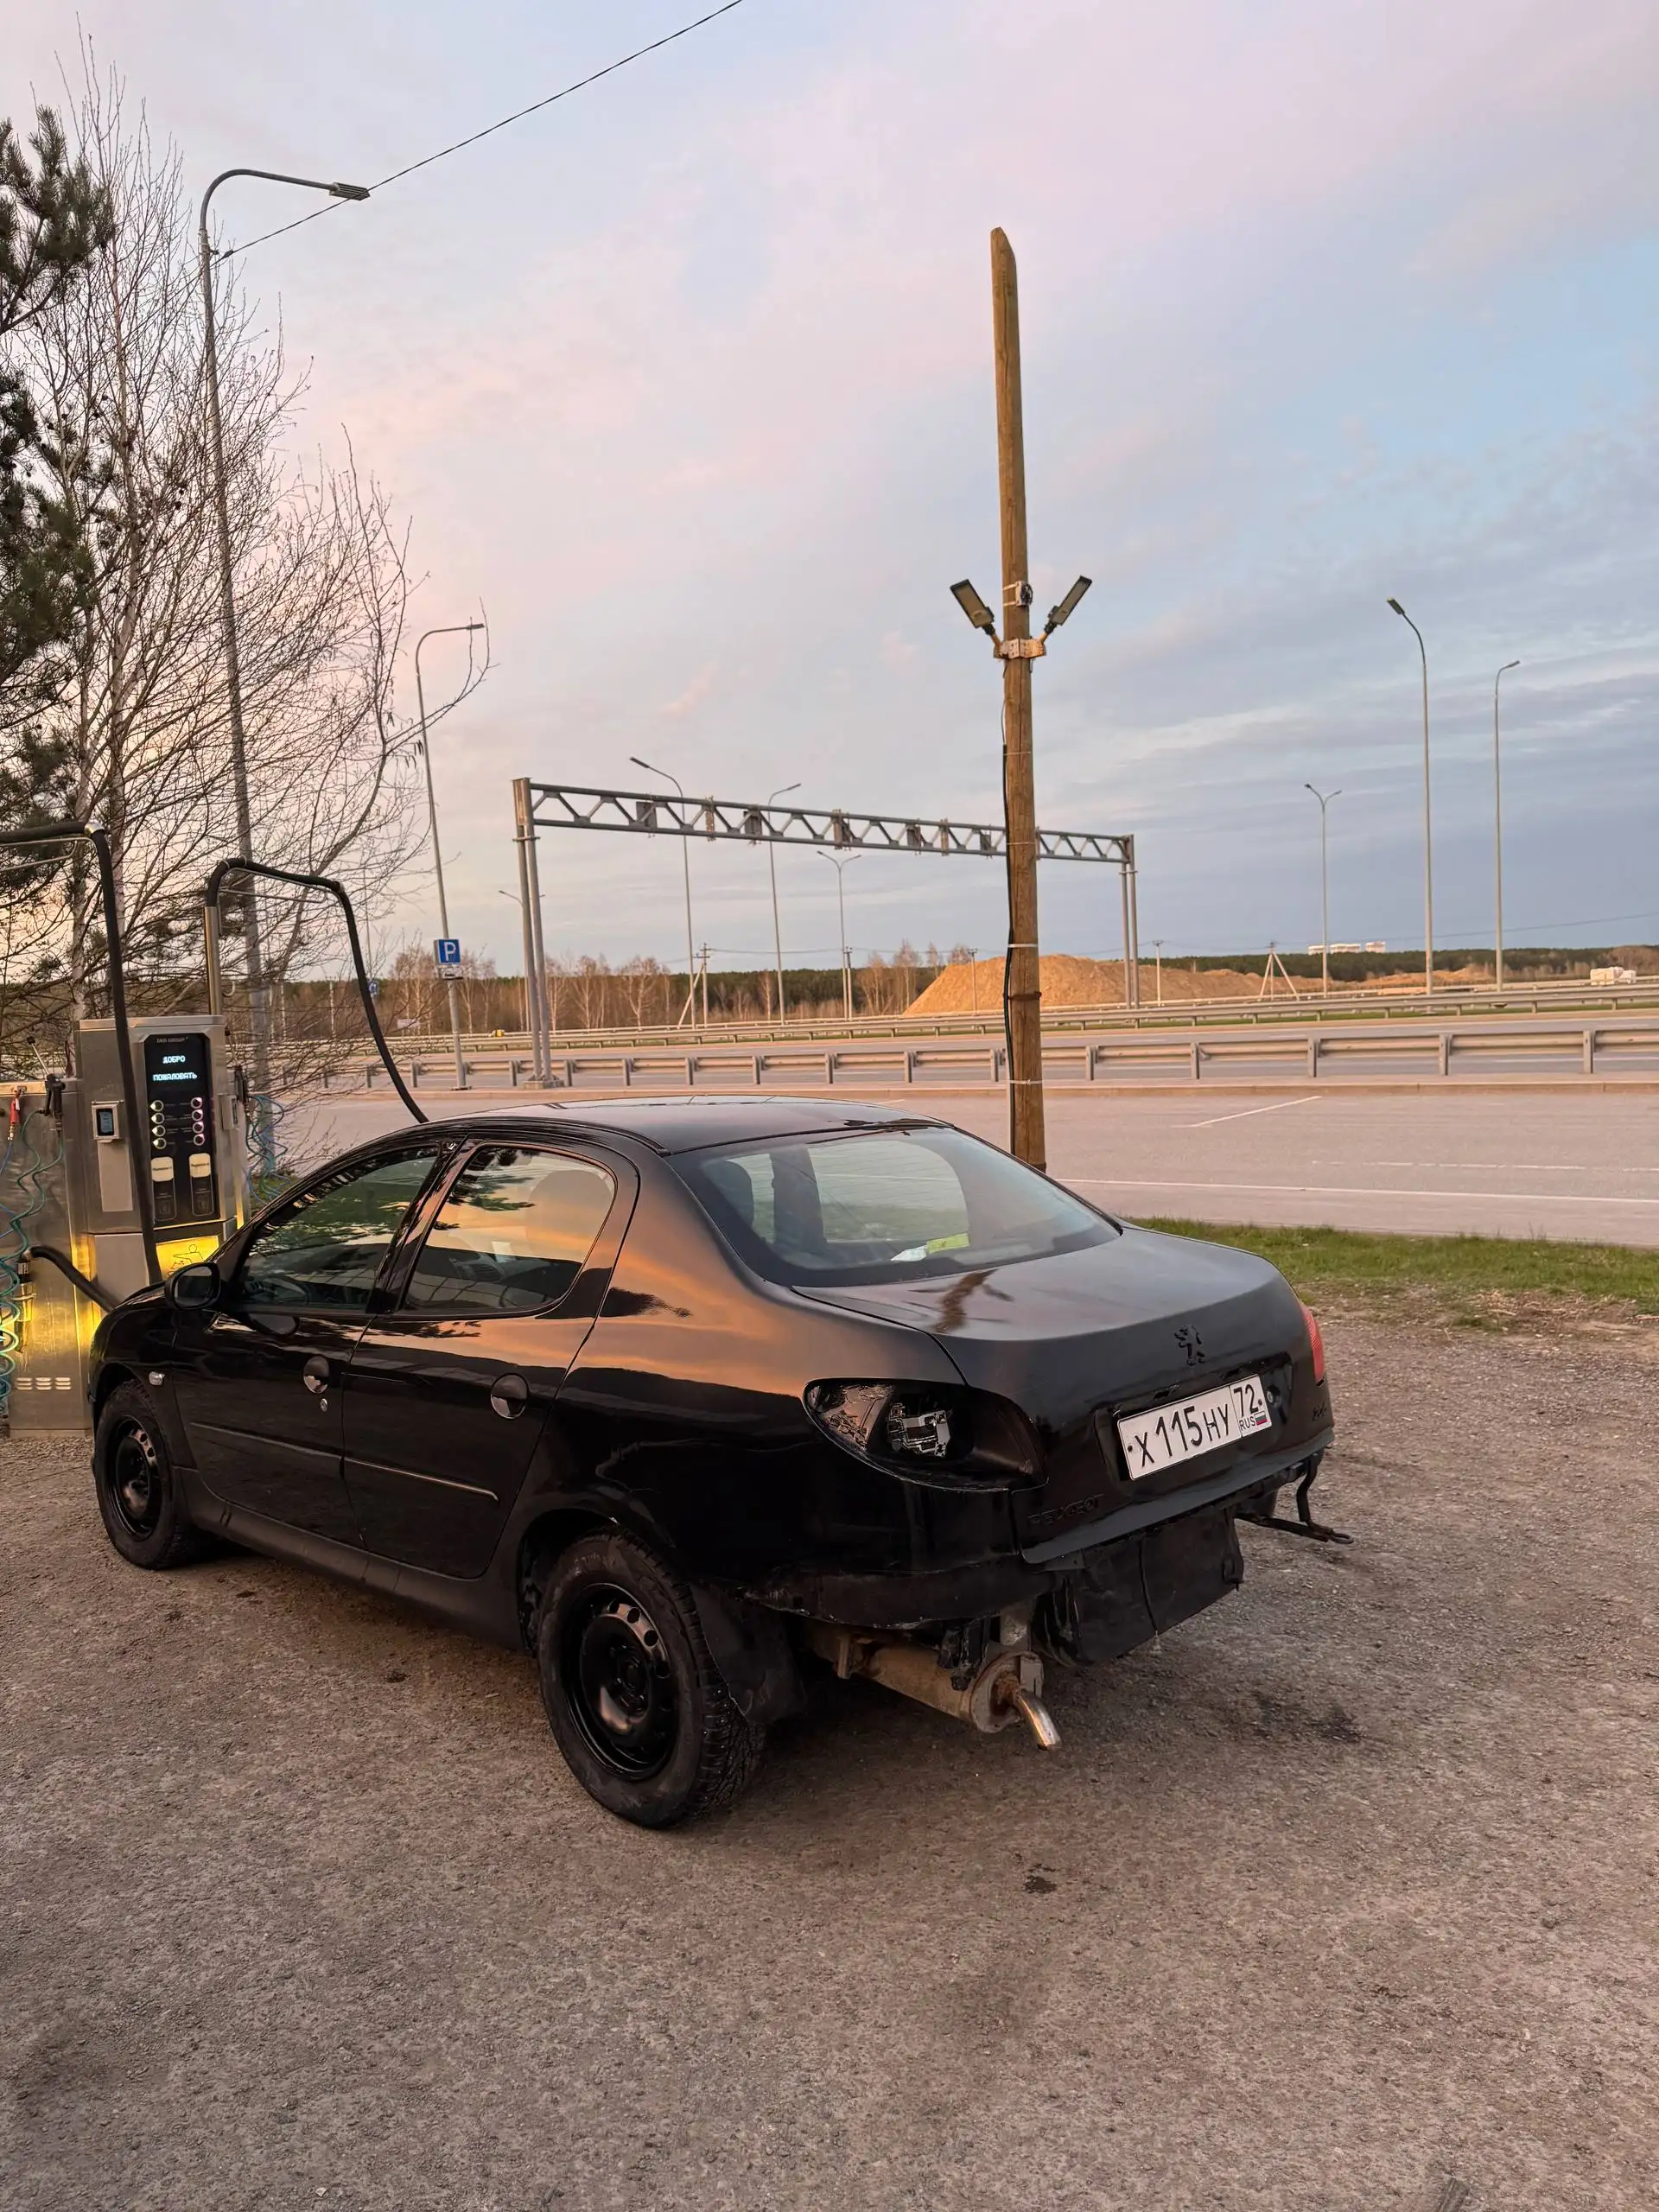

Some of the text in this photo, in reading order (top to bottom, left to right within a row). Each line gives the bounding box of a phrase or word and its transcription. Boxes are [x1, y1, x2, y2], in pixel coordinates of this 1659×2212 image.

[444, 942, 456, 961] P
[153, 1072, 198, 1081] ПОЖАЛОВАТЬ
[1233, 1384, 1259, 1418] 72
[1239, 1415, 1256, 1432] RUS
